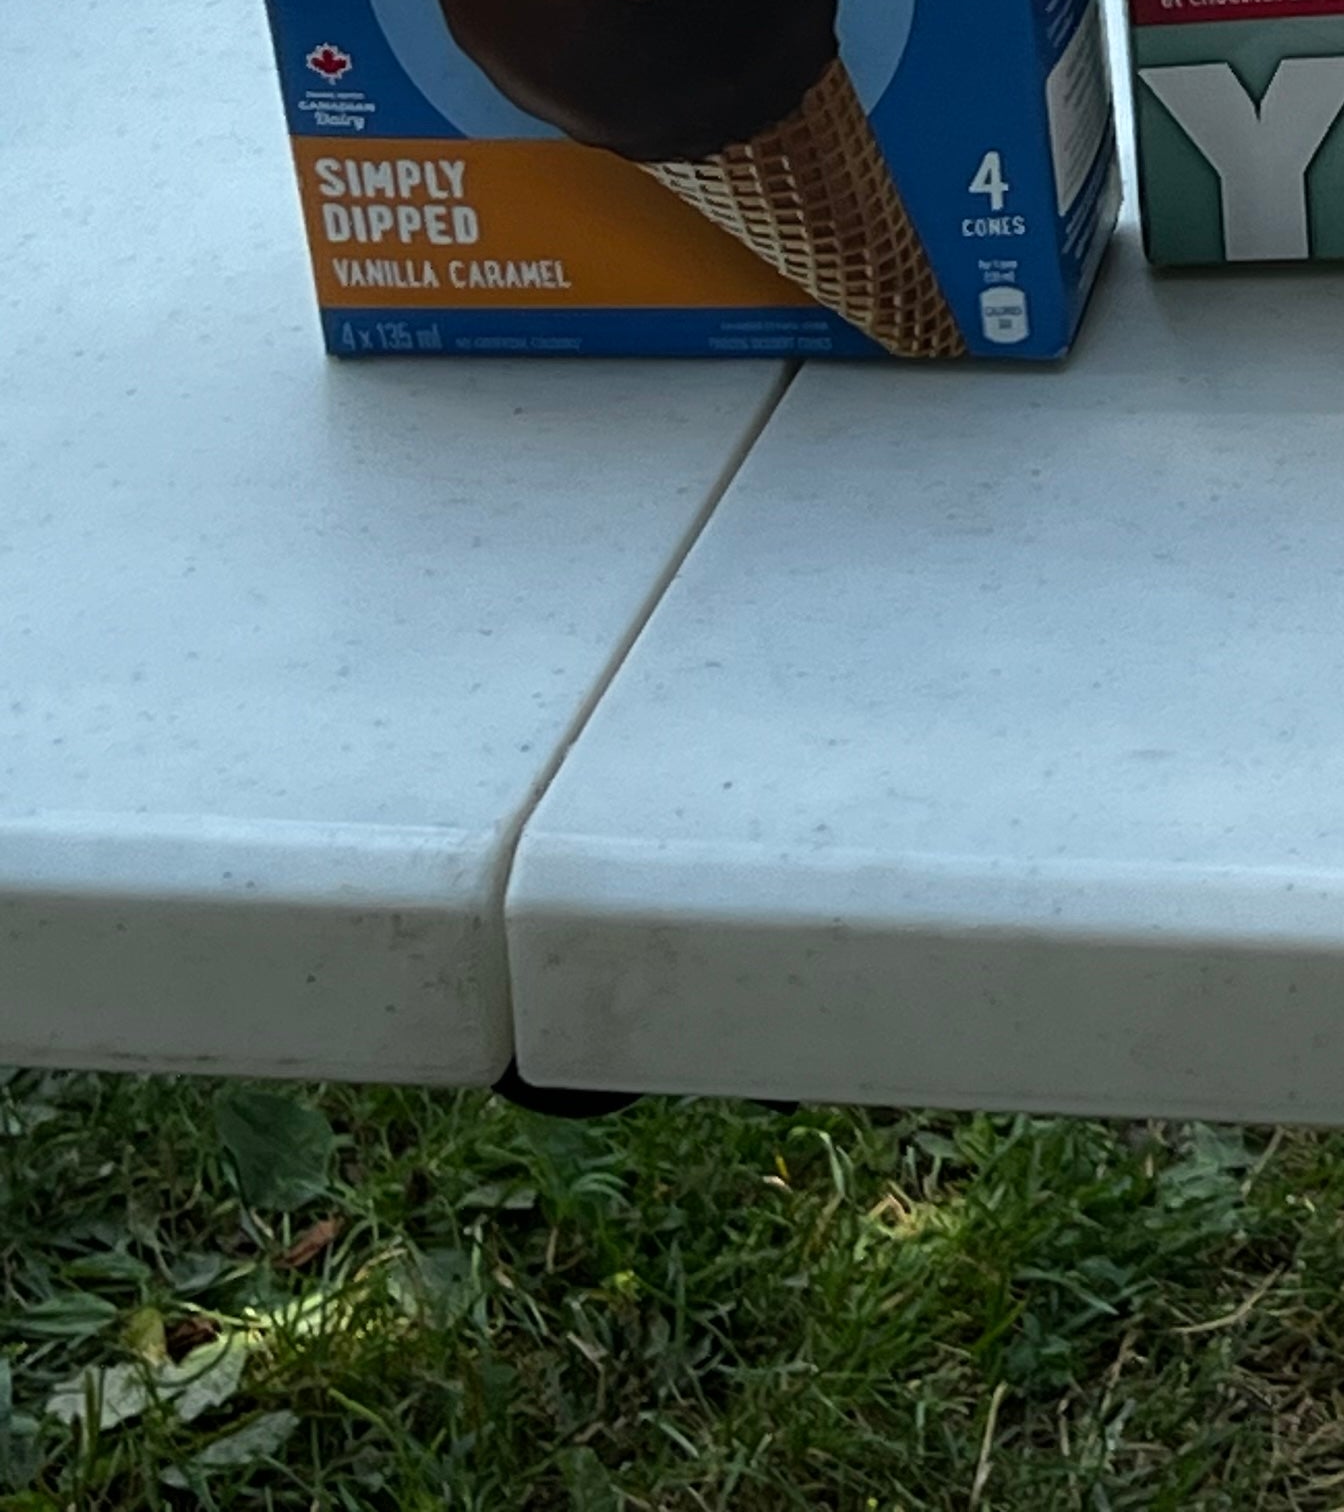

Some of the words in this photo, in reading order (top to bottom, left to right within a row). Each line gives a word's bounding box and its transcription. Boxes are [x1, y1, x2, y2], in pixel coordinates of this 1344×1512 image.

[315, 157, 466, 200] SIMPLY
[967, 150, 1009, 212] 4
[322, 202, 480, 245] DIPPED
[961, 216, 1027, 238] CONES
[332, 257, 441, 290] VANILLA
[448, 259, 573, 290] CARAMEL
